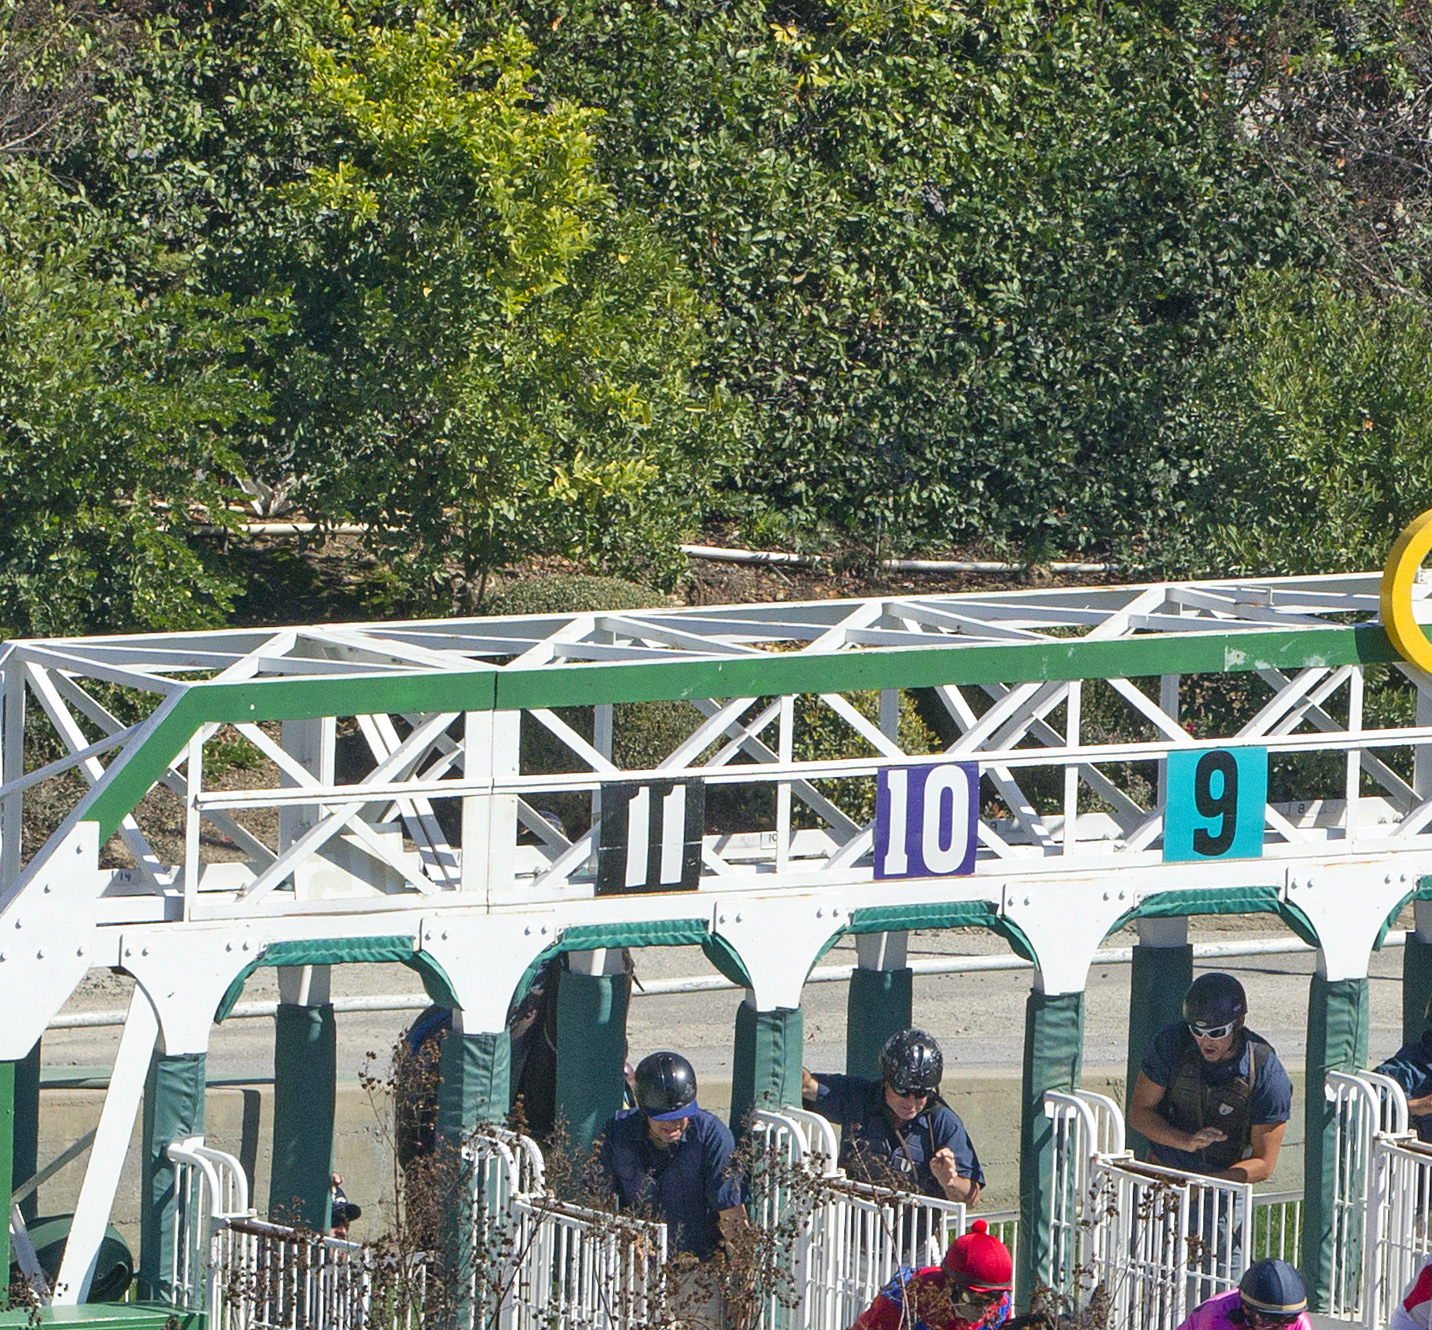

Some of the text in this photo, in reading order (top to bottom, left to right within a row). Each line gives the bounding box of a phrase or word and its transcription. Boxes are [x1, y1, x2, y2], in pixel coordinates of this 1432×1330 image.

[624, 784, 686, 888] 11
[882, 764, 970, 876] 10
[1191, 749, 1238, 857] 9
[1297, 803, 1306, 814] 8
